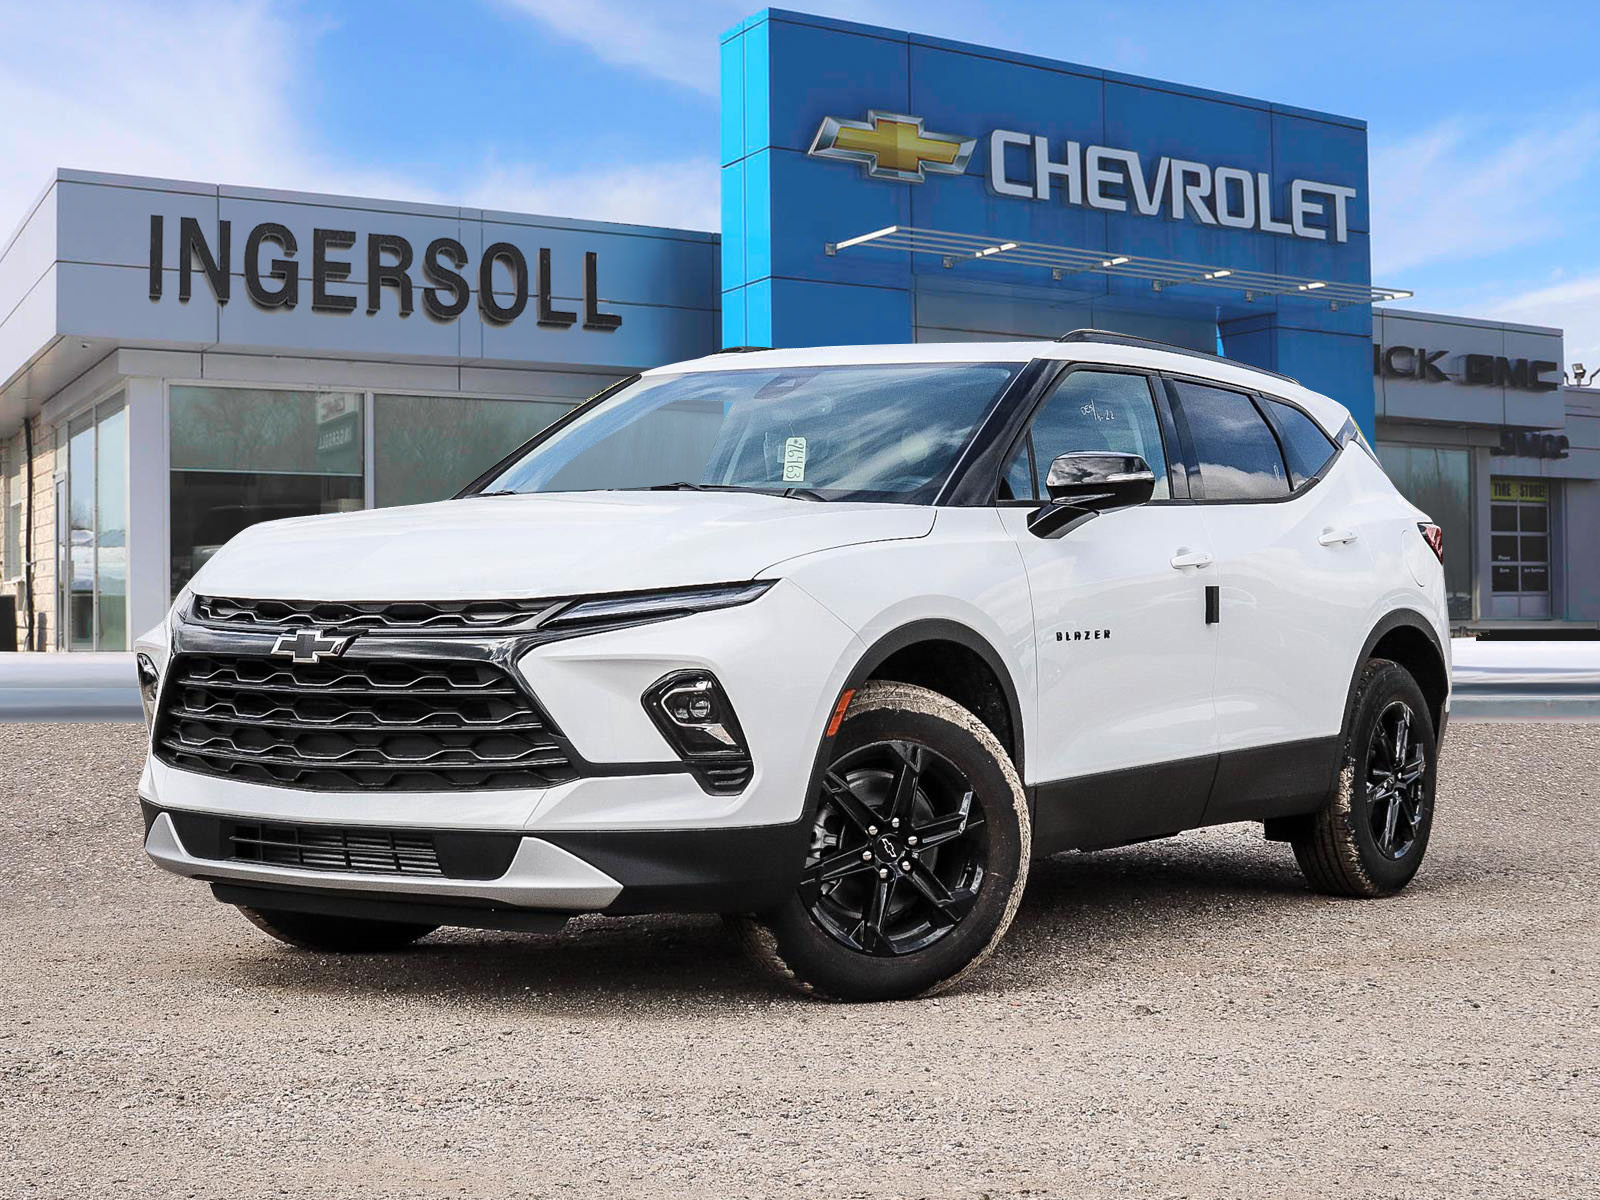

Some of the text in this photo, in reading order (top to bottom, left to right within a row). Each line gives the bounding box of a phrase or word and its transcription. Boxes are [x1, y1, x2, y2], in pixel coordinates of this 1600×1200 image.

[989, 128, 1356, 243] CHEVROLET
[148, 214, 622, 330] INGERSOLL
[1055, 628, 1112, 642] BLAZER
